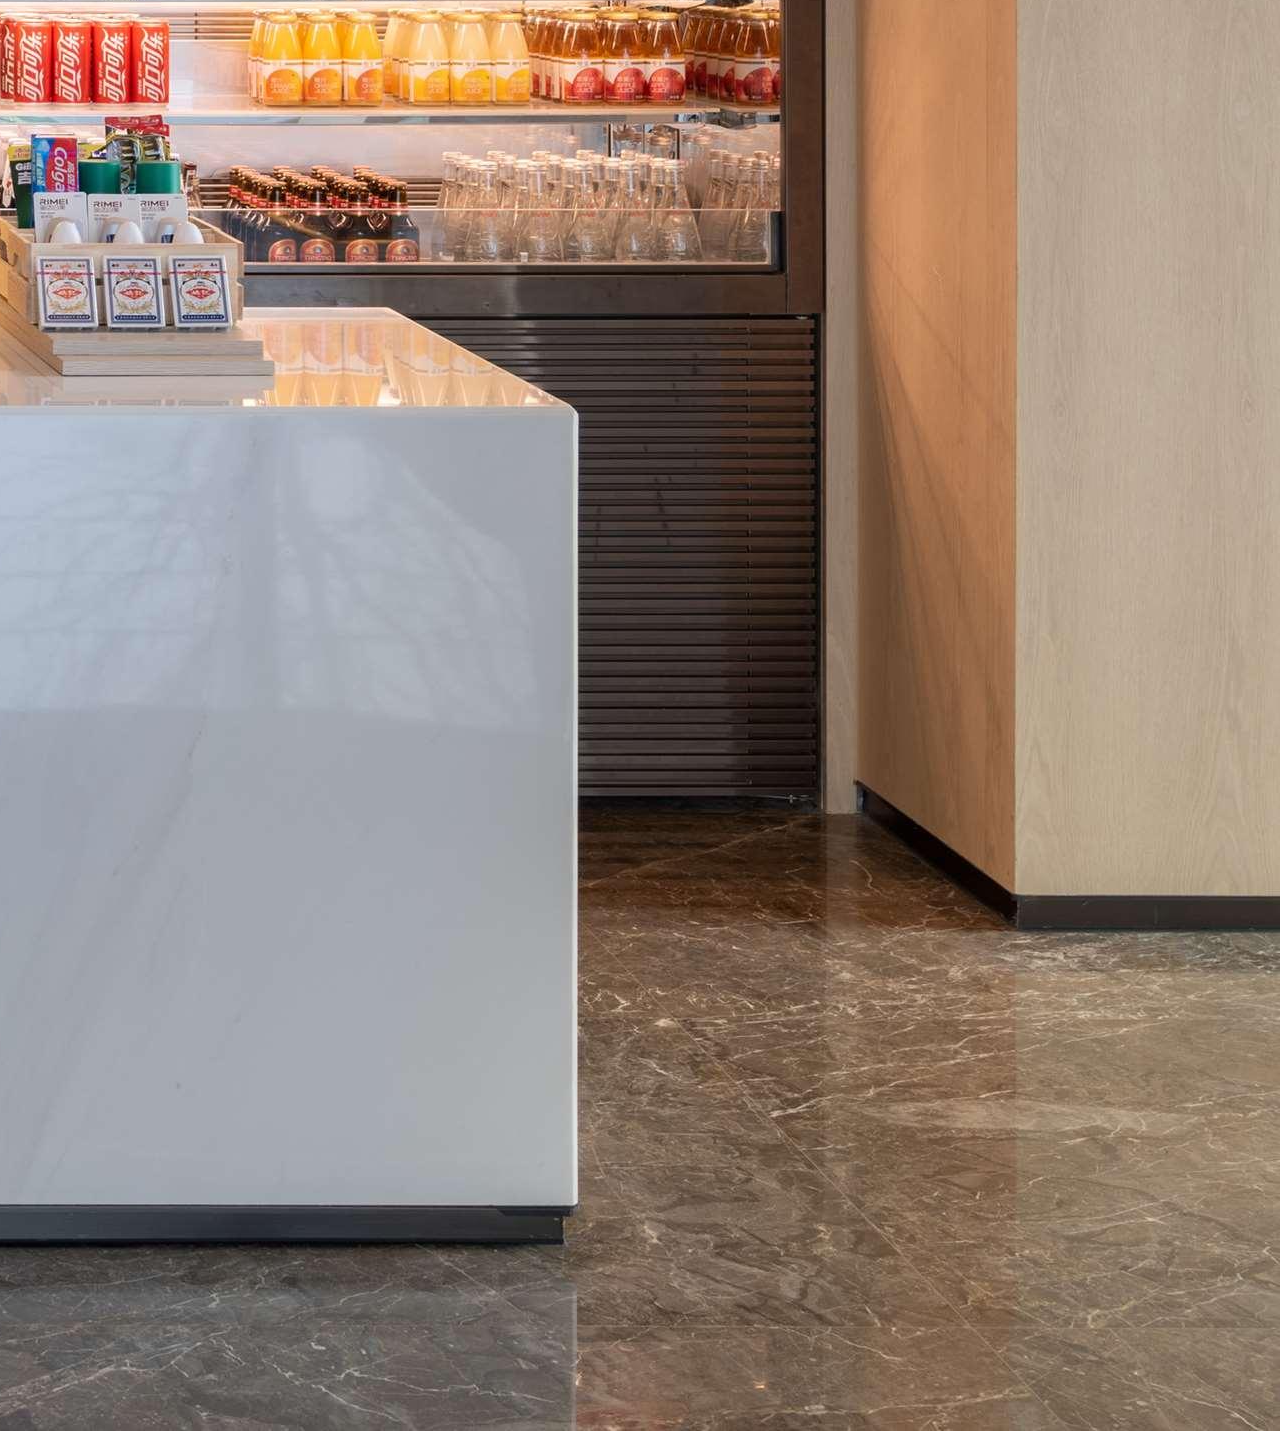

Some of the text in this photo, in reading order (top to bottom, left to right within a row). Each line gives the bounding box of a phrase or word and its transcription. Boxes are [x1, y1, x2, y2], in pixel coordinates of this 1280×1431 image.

[18, 25, 44, 102] 可口可乐
[57, 25, 82, 102] 可口可乐
[100, 26, 126, 102] 可口可乐
[141, 27, 166, 102] 可口可乐
[39, 198, 69, 206] RIMEI
[93, 201, 123, 209] RIMEI
[140, 200, 170, 208] RIMEI
